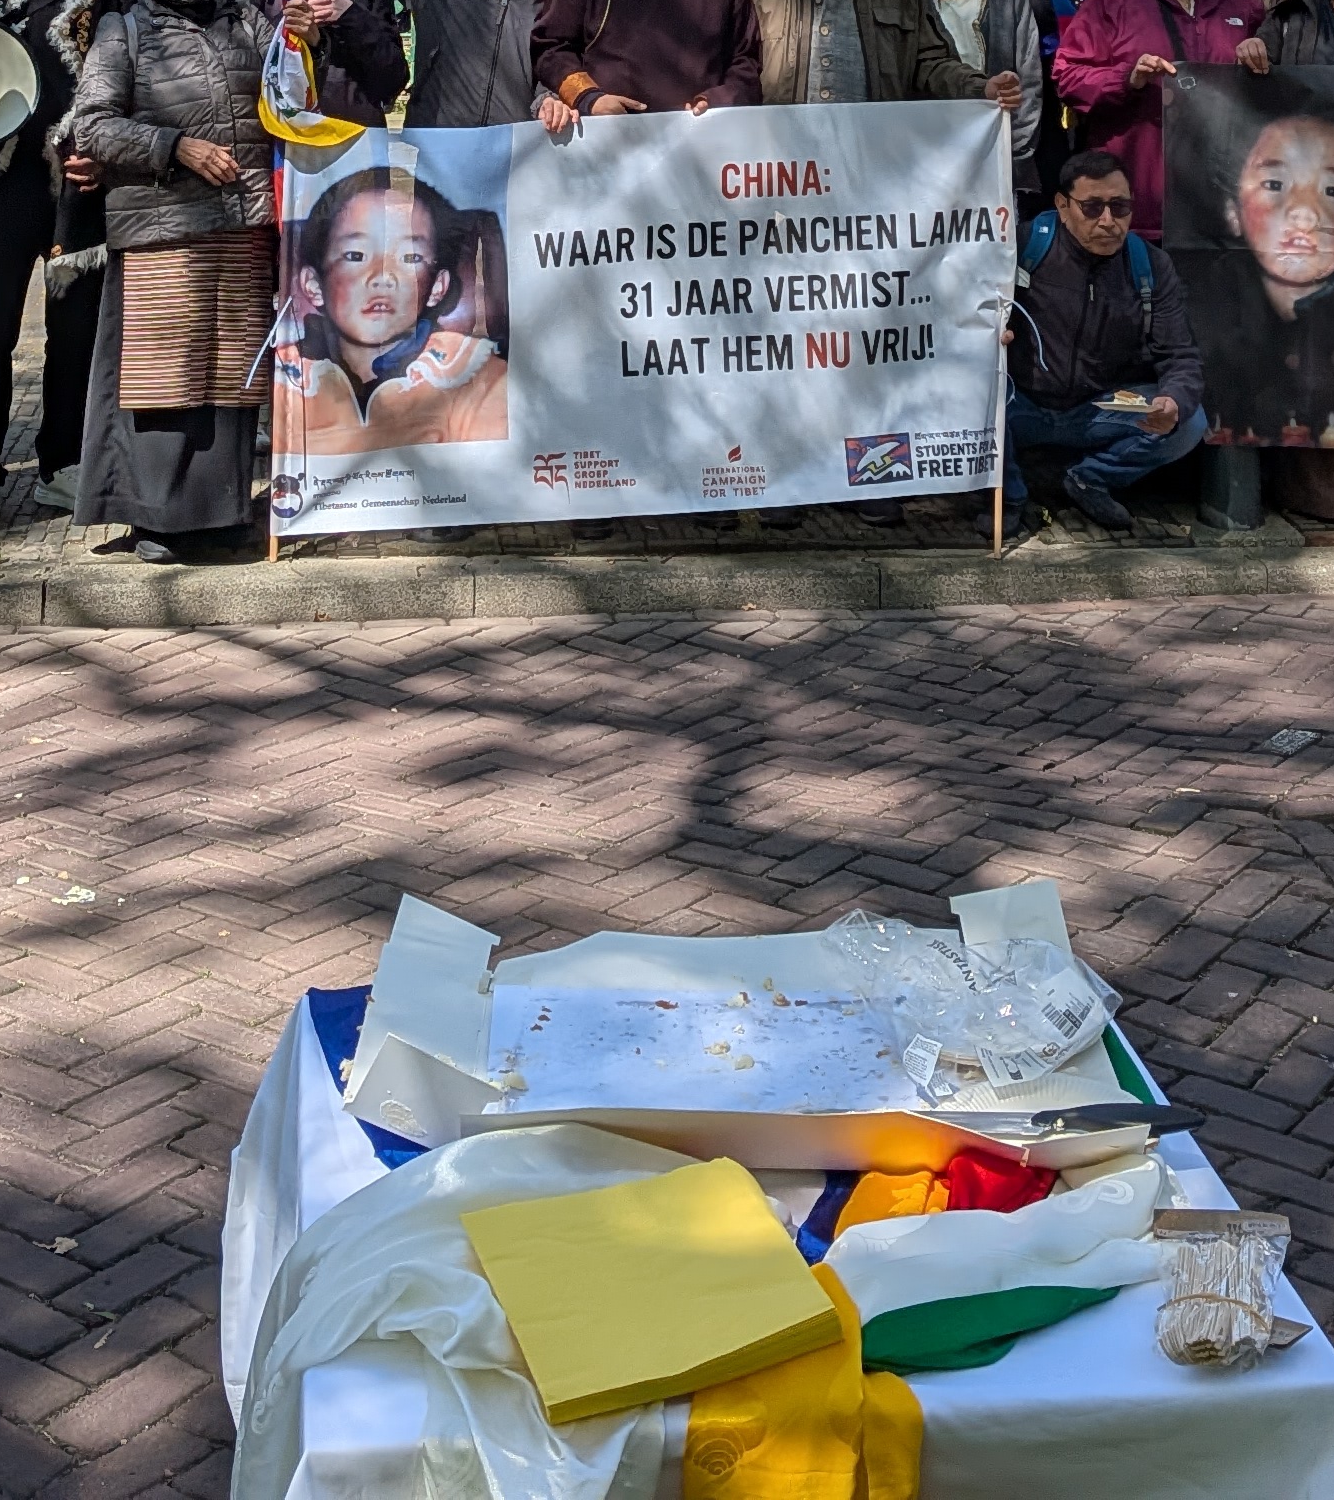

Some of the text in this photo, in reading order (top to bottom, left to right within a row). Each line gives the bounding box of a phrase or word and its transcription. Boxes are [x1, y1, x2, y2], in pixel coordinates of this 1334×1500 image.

[721, 160, 831, 199] CHINA:
[533, 206, 1010, 269] WAAR IS DE PANCHEN LAMA?
[620, 270, 931, 319] 31 JAAR VERMIST...
[620, 324, 934, 377] LAAT HEM NU VRIJ!
[573, 450, 601, 459] TIBET
[916, 443, 977, 458] STUDENTS
[573, 459, 619, 469] SUPPORT
[702, 466, 765, 475] INTERNATIONAL
[917, 454, 998, 478] FREE TIBET
[574, 470, 608, 479] GROEP
[702, 476, 766, 487] CAMPAIGN
[574, 478, 636, 489] NEDERLAND
[702, 486, 766, 498] FOR TIBET
[314, 493, 467, 511] Tibetaanse Gemeenschap Nederland
[927, 939, 981, 997] ANTASTISK
